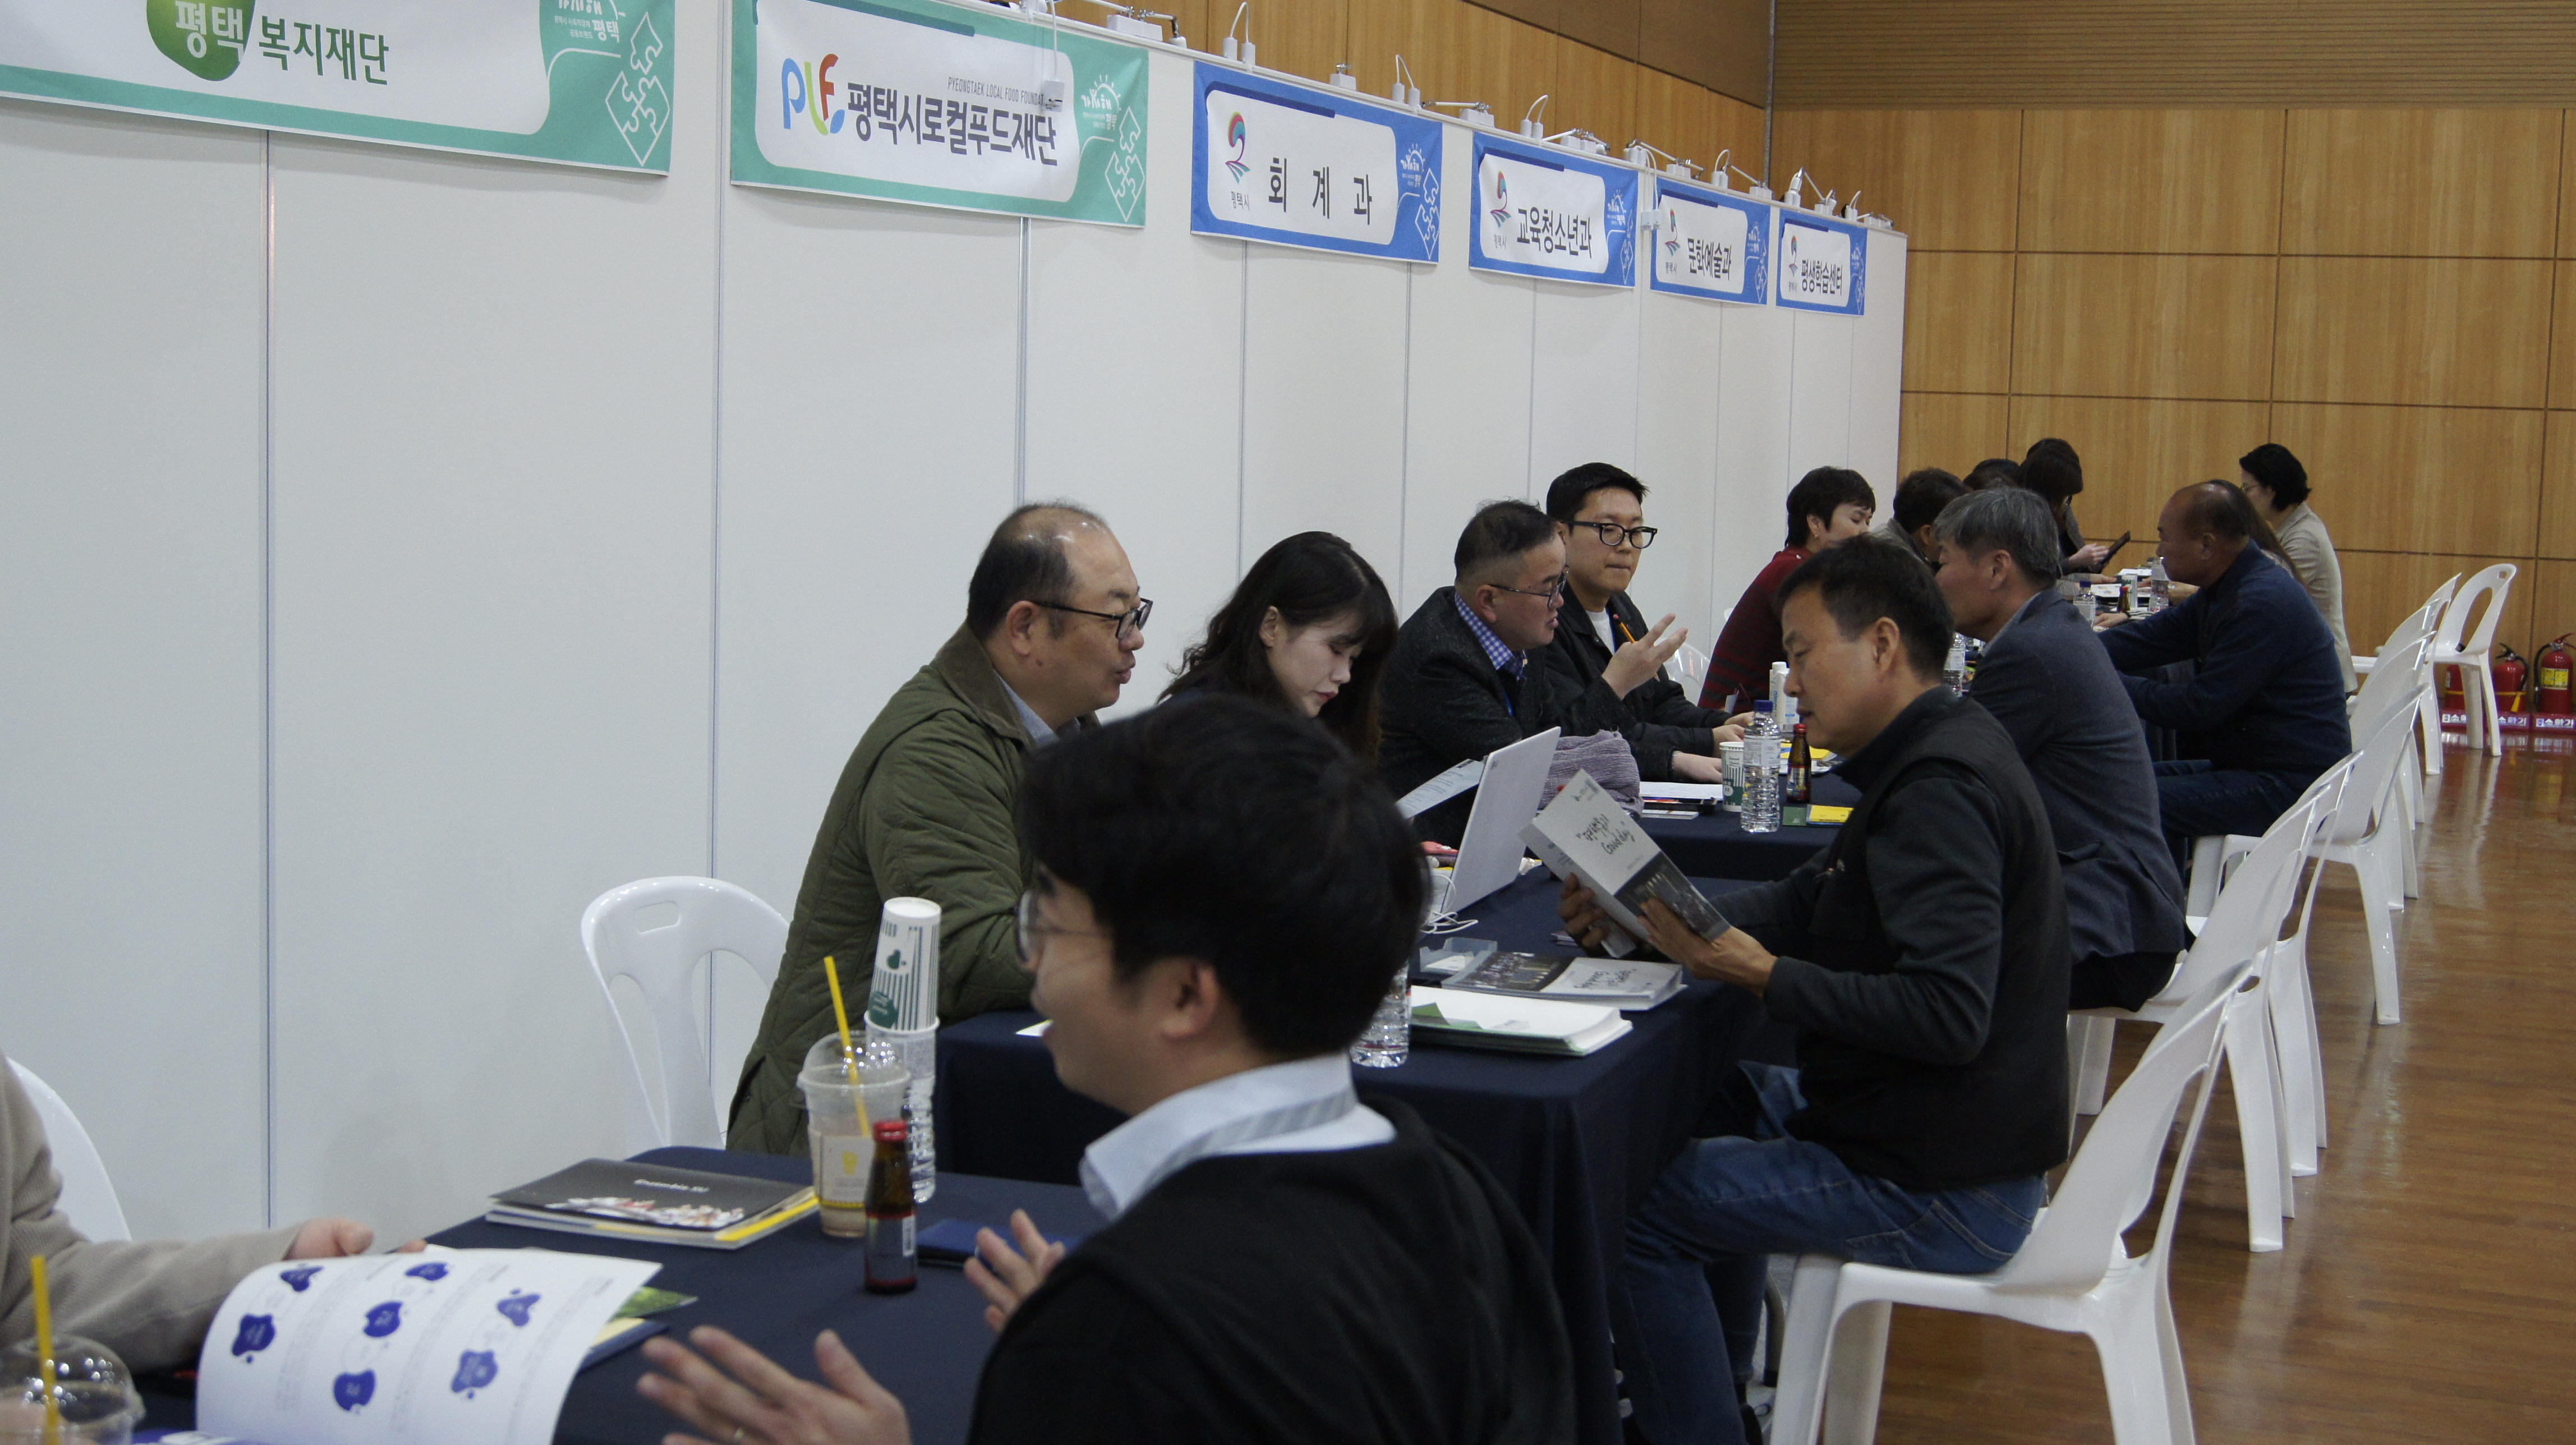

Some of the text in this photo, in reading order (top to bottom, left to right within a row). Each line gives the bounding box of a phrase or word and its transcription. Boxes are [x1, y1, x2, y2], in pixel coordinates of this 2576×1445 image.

[175, 1, 389, 85] 평택 복지재단
[592, 19, 619, 43] 평택
[948, 76, 985, 96] PYEONGTAEK
[986, 84, 1003, 99] LOCAL
[1005, 88, 1019, 102] FOOD
[848, 82, 1057, 165] 평택시로컬푸드재단
[1231, 191, 1250, 211] 평택시
[1517, 206, 1591, 258] 교육청소년과
[1687, 238, 1732, 280] 문화예술과
[1801, 259, 1843, 296] 평생학습센터
[2545, 719, 2574, 728] 소화기
